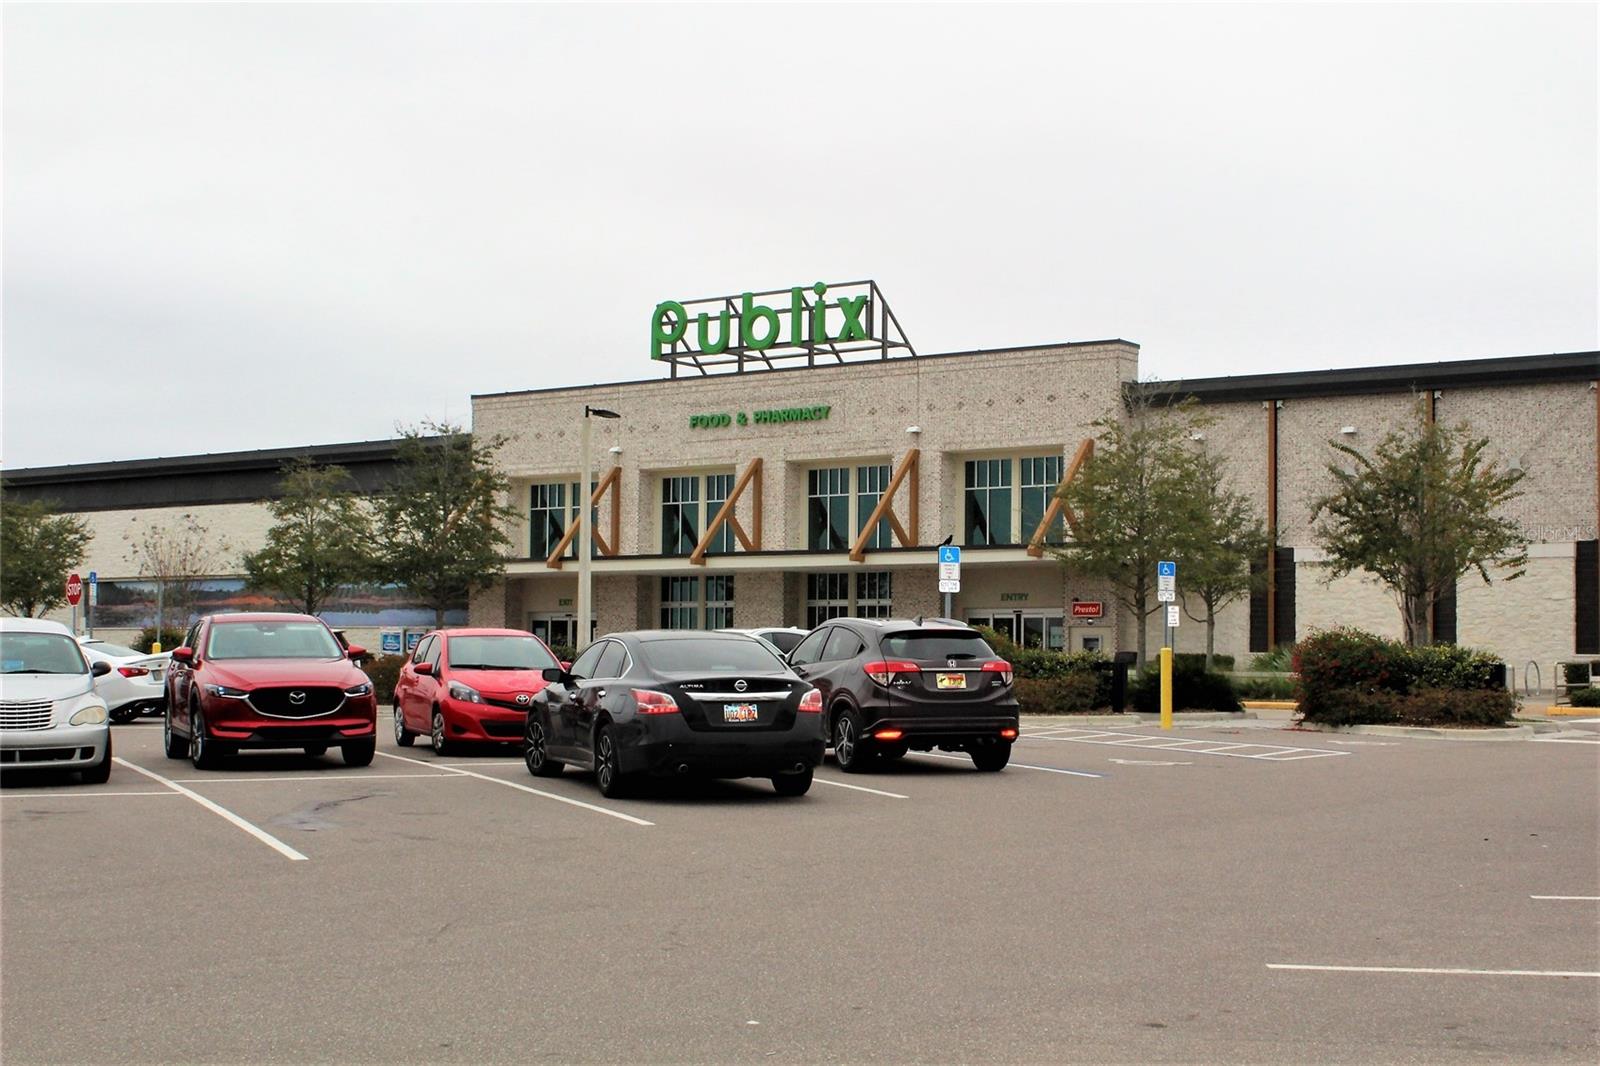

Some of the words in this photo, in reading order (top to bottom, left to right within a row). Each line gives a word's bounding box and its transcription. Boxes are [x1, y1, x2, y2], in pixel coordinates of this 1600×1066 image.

[651, 281, 868, 360] Publix
[690, 413, 731, 429] FOOD
[736, 410, 748, 426] &
[753, 405, 832, 423] PHARMACY
[68, 583, 81, 596] STOP
[559, 598, 573, 606] EXIT
[1001, 593, 1030, 601] ENTRY
[1074, 604, 1100, 614] Presto!
